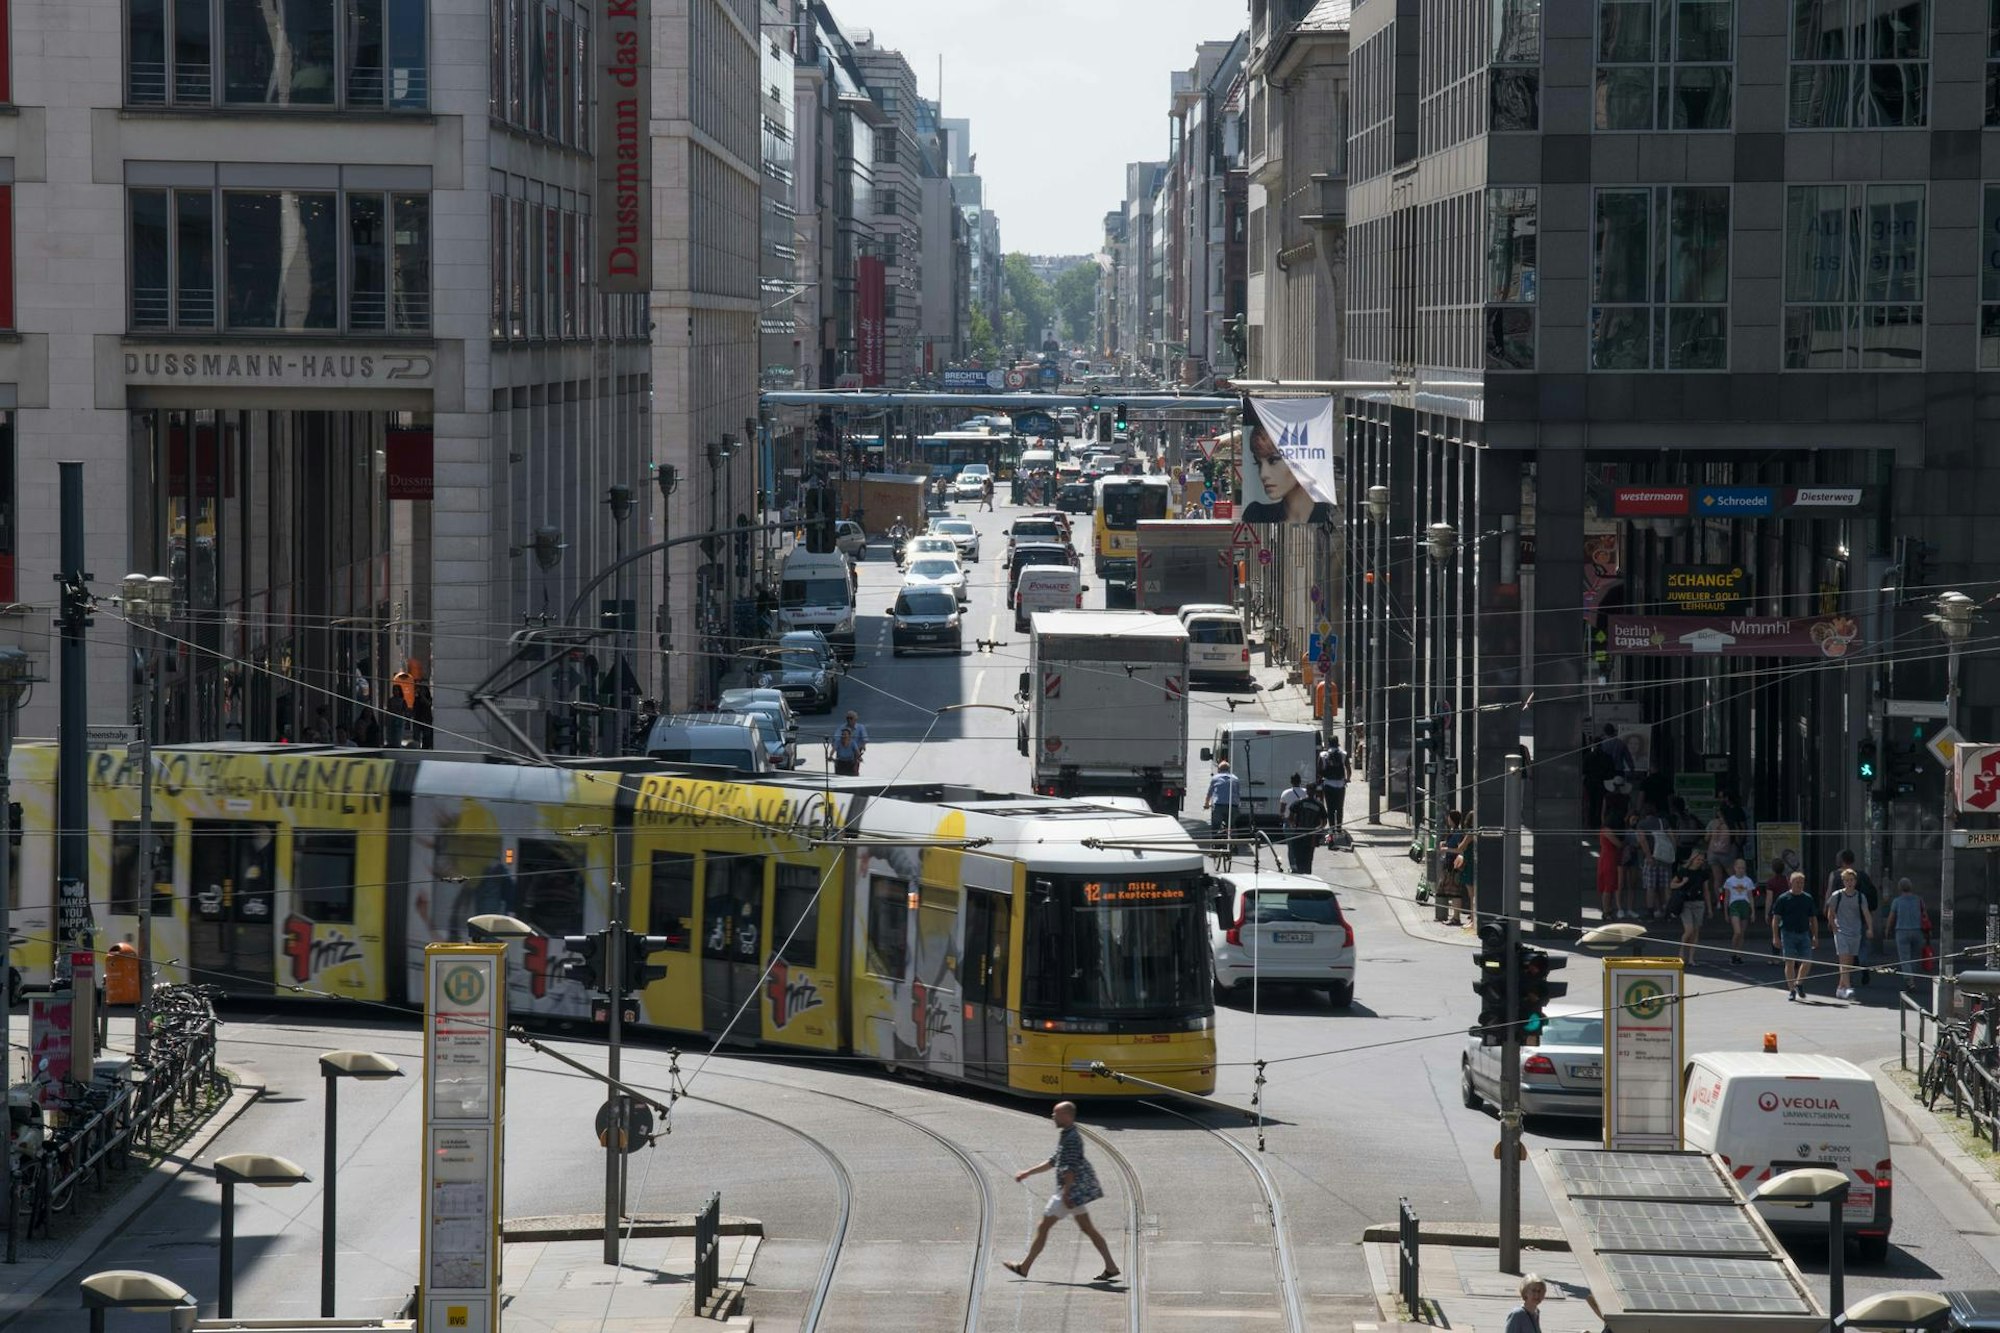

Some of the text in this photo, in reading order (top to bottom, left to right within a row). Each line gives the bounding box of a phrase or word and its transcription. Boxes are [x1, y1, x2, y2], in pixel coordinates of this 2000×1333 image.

[608, 0, 637, 277] Dussmann das K
[125, 353, 375, 379] DUSSMANN-HAUS
[944, 371, 986, 380] BRECHTEL
[1278, 446, 1326, 460] ARITIM
[390, 474, 432, 487] Dussm
[1620, 491, 1684, 502] westermann
[1717, 495, 1768, 507] Schroedel
[1801, 491, 1854, 504] Diesterweg
[1614, 623, 1650, 637] berlin
[1731, 619, 1790, 635] Mmmh!
[1614, 636, 1650, 648] tapas
[641, 779, 714, 828] RADIO
[1967, 834, 2000, 844] PHARM
[1084, 882, 1157, 902] 12 Mitte
[60, 897, 88, 908] MAKES
[65, 908, 83, 918] YOU
[1781, 1097, 1840, 1111] VEOLIA
[1782, 1111, 1851, 1121] UMWELTSERVICE
[449, 1316, 466, 1326] BVG
